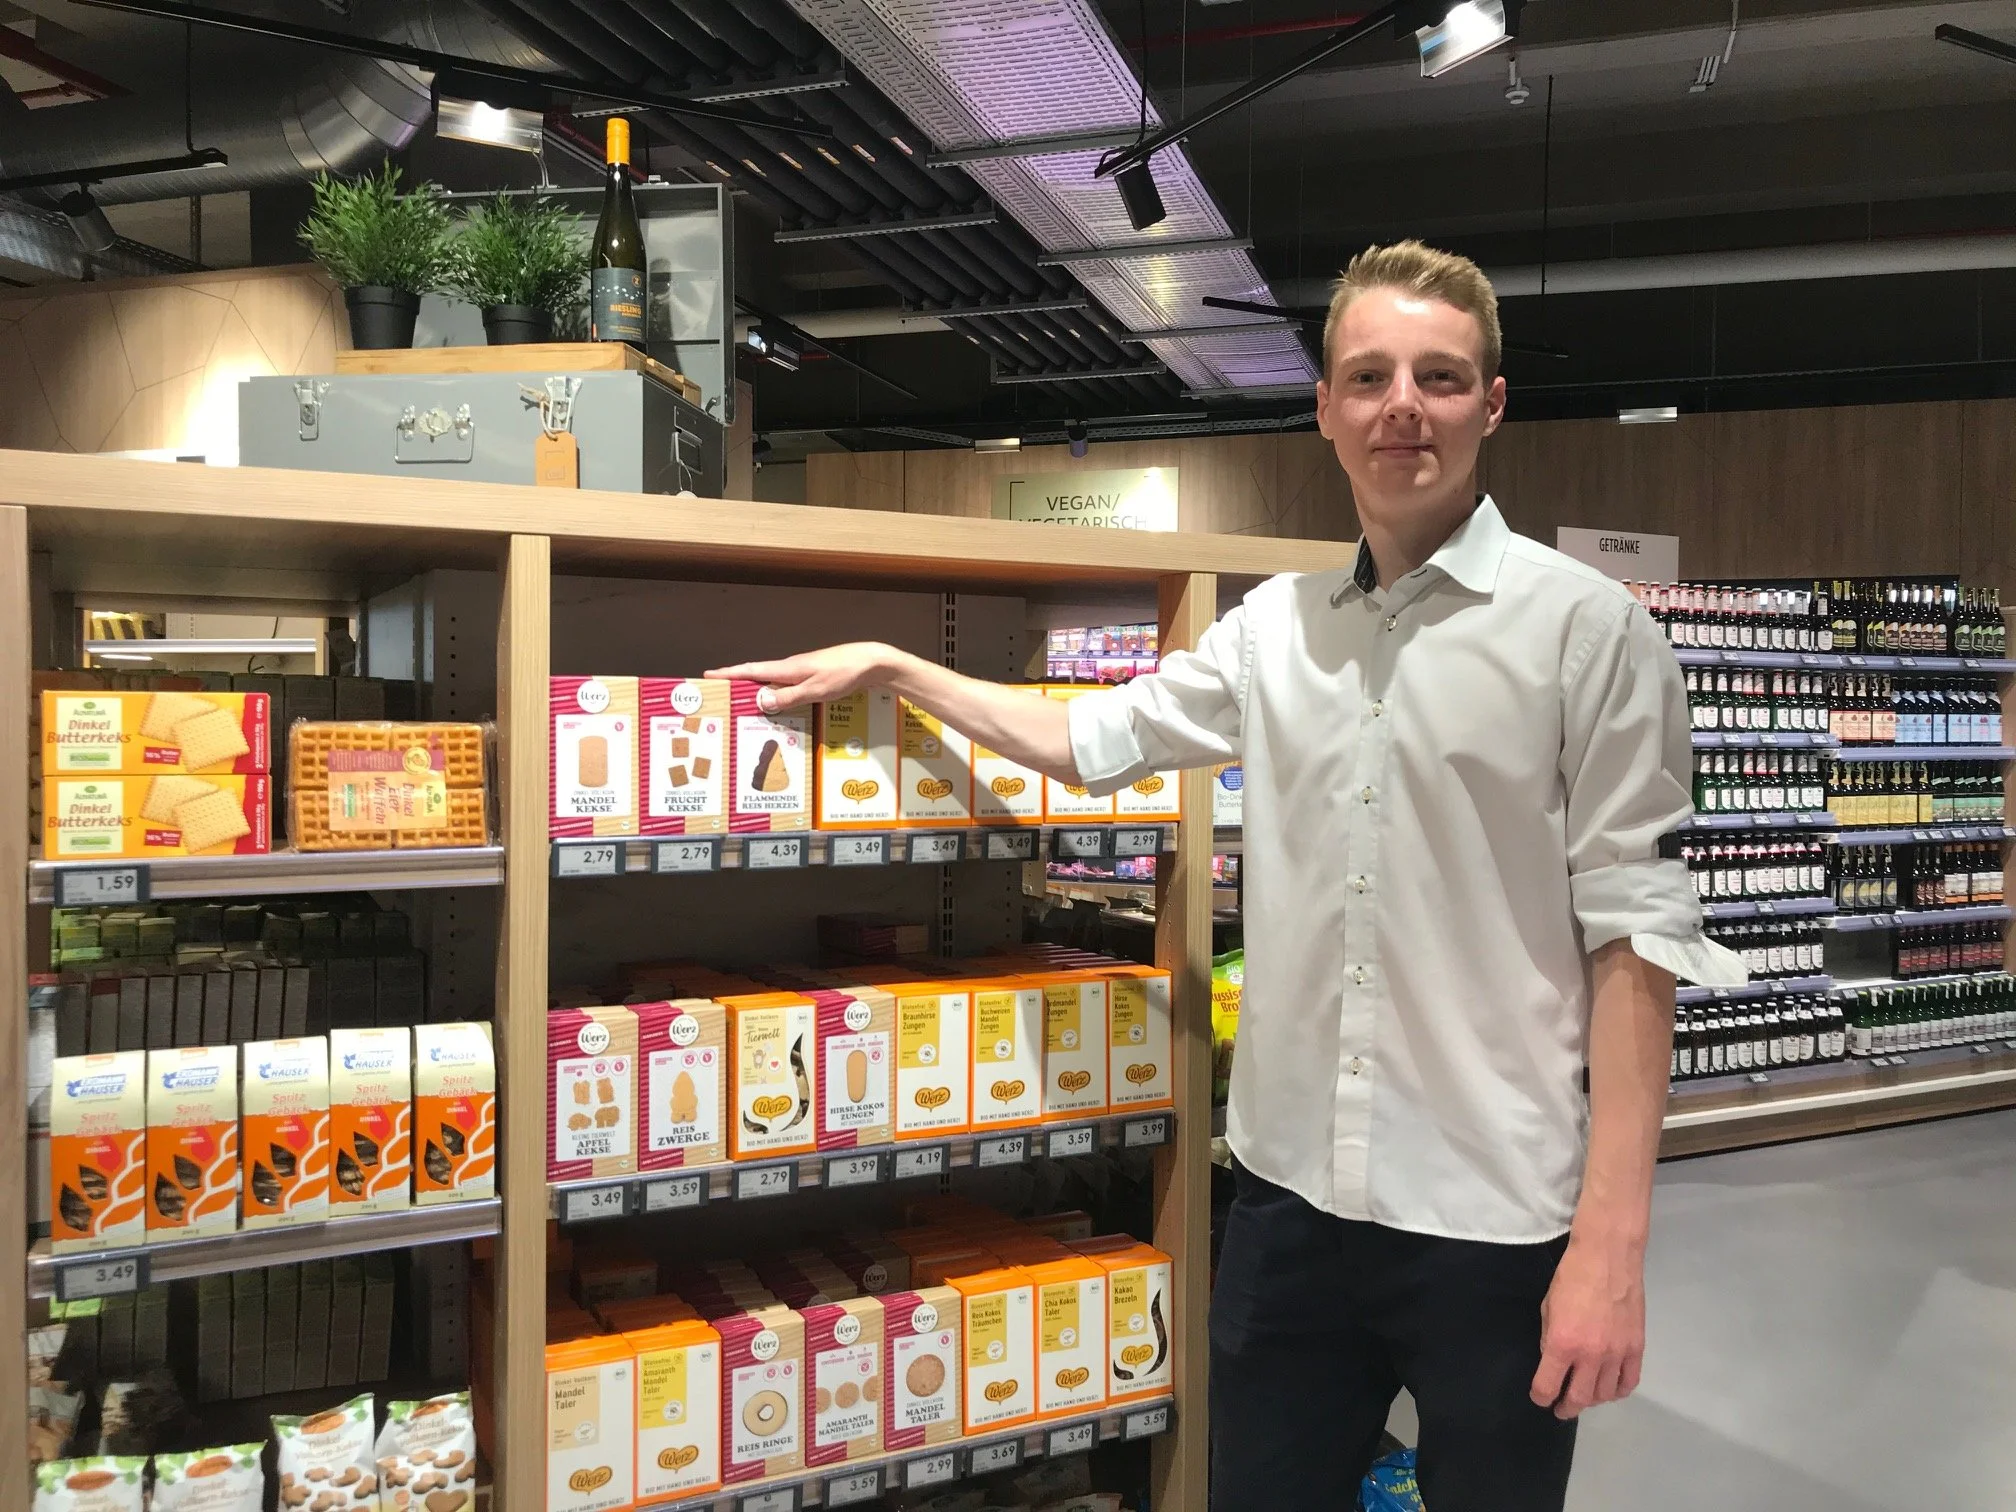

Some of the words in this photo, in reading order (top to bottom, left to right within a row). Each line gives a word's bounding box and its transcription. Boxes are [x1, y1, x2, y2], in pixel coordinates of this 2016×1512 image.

[609, 304, 641, 314] RIESLING
[1046, 493, 1121, 511] VEGAN/
[1600, 536, 1640, 554] GETRÄNKE
[830, 713, 850, 722] Kekse
[68, 720, 111, 730] Dinkel
[46, 732, 131, 744] Butterkeks
[846, 782, 874, 797] Werz
[922, 782, 948, 796] Werz
[996, 780, 1020, 794] Werz
[1138, 779, 1160, 792] Werz
[402, 782, 415, 817] Dinkel
[571, 796, 617, 804] MANDEL
[664, 796, 708, 804] FRUCHT
[69, 804, 112, 814] Dinkel
[576, 805, 612, 813] KEKSE
[668, 804, 704, 812] KEKSE
[742, 802, 762, 810] REIS
[48, 816, 133, 828] Butterkeks
[932, 840, 956, 852] 3,49
[1076, 836, 1099, 847] 4,39
[1132, 834, 1155, 847] 2,99
[681, 846, 710, 860] 2,79
[770, 844, 798, 858] 4,39
[855, 842, 880, 855] 3,49
[584, 850, 614, 864] 2,79
[97, 875, 134, 891] 1,59
[1046, 1008, 1068, 1016] Zungen
[1220, 1002, 1238, 1012] Bro
[846, 1010, 869, 1020] Werz
[902, 1012, 936, 1021] Braunhirse
[672, 1024, 696, 1035] Werz
[902, 1021, 926, 1030] Zungen
[980, 1023, 1000, 1031] Zungen
[581, 1031, 606, 1043] Werz
[355, 1060, 392, 1068] HAUSER
[272, 1068, 310, 1077] HAUSER
[1130, 1068, 1152, 1080] Werz
[176, 1077, 218, 1087] HAUSER
[443, 1075, 472, 1086] Spritz
[1062, 1076, 1086, 1088] Werz
[356, 1084, 388, 1094] Spritz
[996, 1084, 1020, 1098] Werz
[272, 1092, 306, 1104] Spritz
[920, 1092, 946, 1104] Werz
[176, 1104, 211, 1115] Spritz
[757, 1100, 786, 1114] Werz
[830, 1106, 855, 1114] HIRSE
[856, 1102, 884, 1112] KOKOS
[840, 1110, 874, 1120] ZUNGEN
[672, 1125, 696, 1134] REIS
[1142, 1124, 1163, 1136] 3,99
[578, 1138, 610, 1148] APFEL
[658, 1132, 710, 1146] ZWERGE
[1068, 1132, 1090, 1146] 3,59
[576, 1146, 612, 1156] KEKSE
[998, 1141, 1022, 1155] 4,39
[916, 1152, 940, 1166] 4,19
[850, 1160, 876, 1174] 3,99
[760, 1171, 788, 1186] 2,79
[670, 1182, 698, 1197] 3,59
[592, 1192, 621, 1208] 3,49
[96, 1264, 134, 1282] 3,49
[1114, 1286, 1134, 1294] Kakao
[1044, 1299, 1058, 1308] Chia
[1060, 1297, 1076, 1305] Kokos
[1114, 1294, 1138, 1304] Brezeln
[914, 1312, 936, 1323] Werz
[1044, 1308, 1060, 1316] Taler
[836, 1324, 858, 1334] Werz
[754, 1340, 776, 1350] Werz
[1126, 1348, 1150, 1362] Werz
[643, 1366, 676, 1377] Amaranth
[643, 1377, 668, 1386] Mandel
[1060, 1372, 1086, 1386] Werz
[555, 1386, 586, 1400] Mandel
[643, 1386, 660, 1394] Taler
[990, 1384, 1013, 1398] Werz
[555, 1400, 576, 1410] Taler
[906, 1404, 946, 1417] MANDEL
[826, 1414, 868, 1428] AMARANTH
[910, 1413, 940, 1424] TALER
[1144, 1412, 1166, 1426] 3,59
[818, 1425, 850, 1436] MANDEL
[851, 1420, 874, 1430] TALER
[1068, 1428, 1090, 1443] 3,49
[738, 1443, 760, 1453] REIS
[762, 1436, 794, 1448] RINGE
[664, 1451, 693, 1466] Werz
[992, 1445, 1015, 1460] 3,69
[927, 1458, 952, 1474] 2,99
[576, 1472, 606, 1488] Werz
[850, 1476, 876, 1491] 3,59
